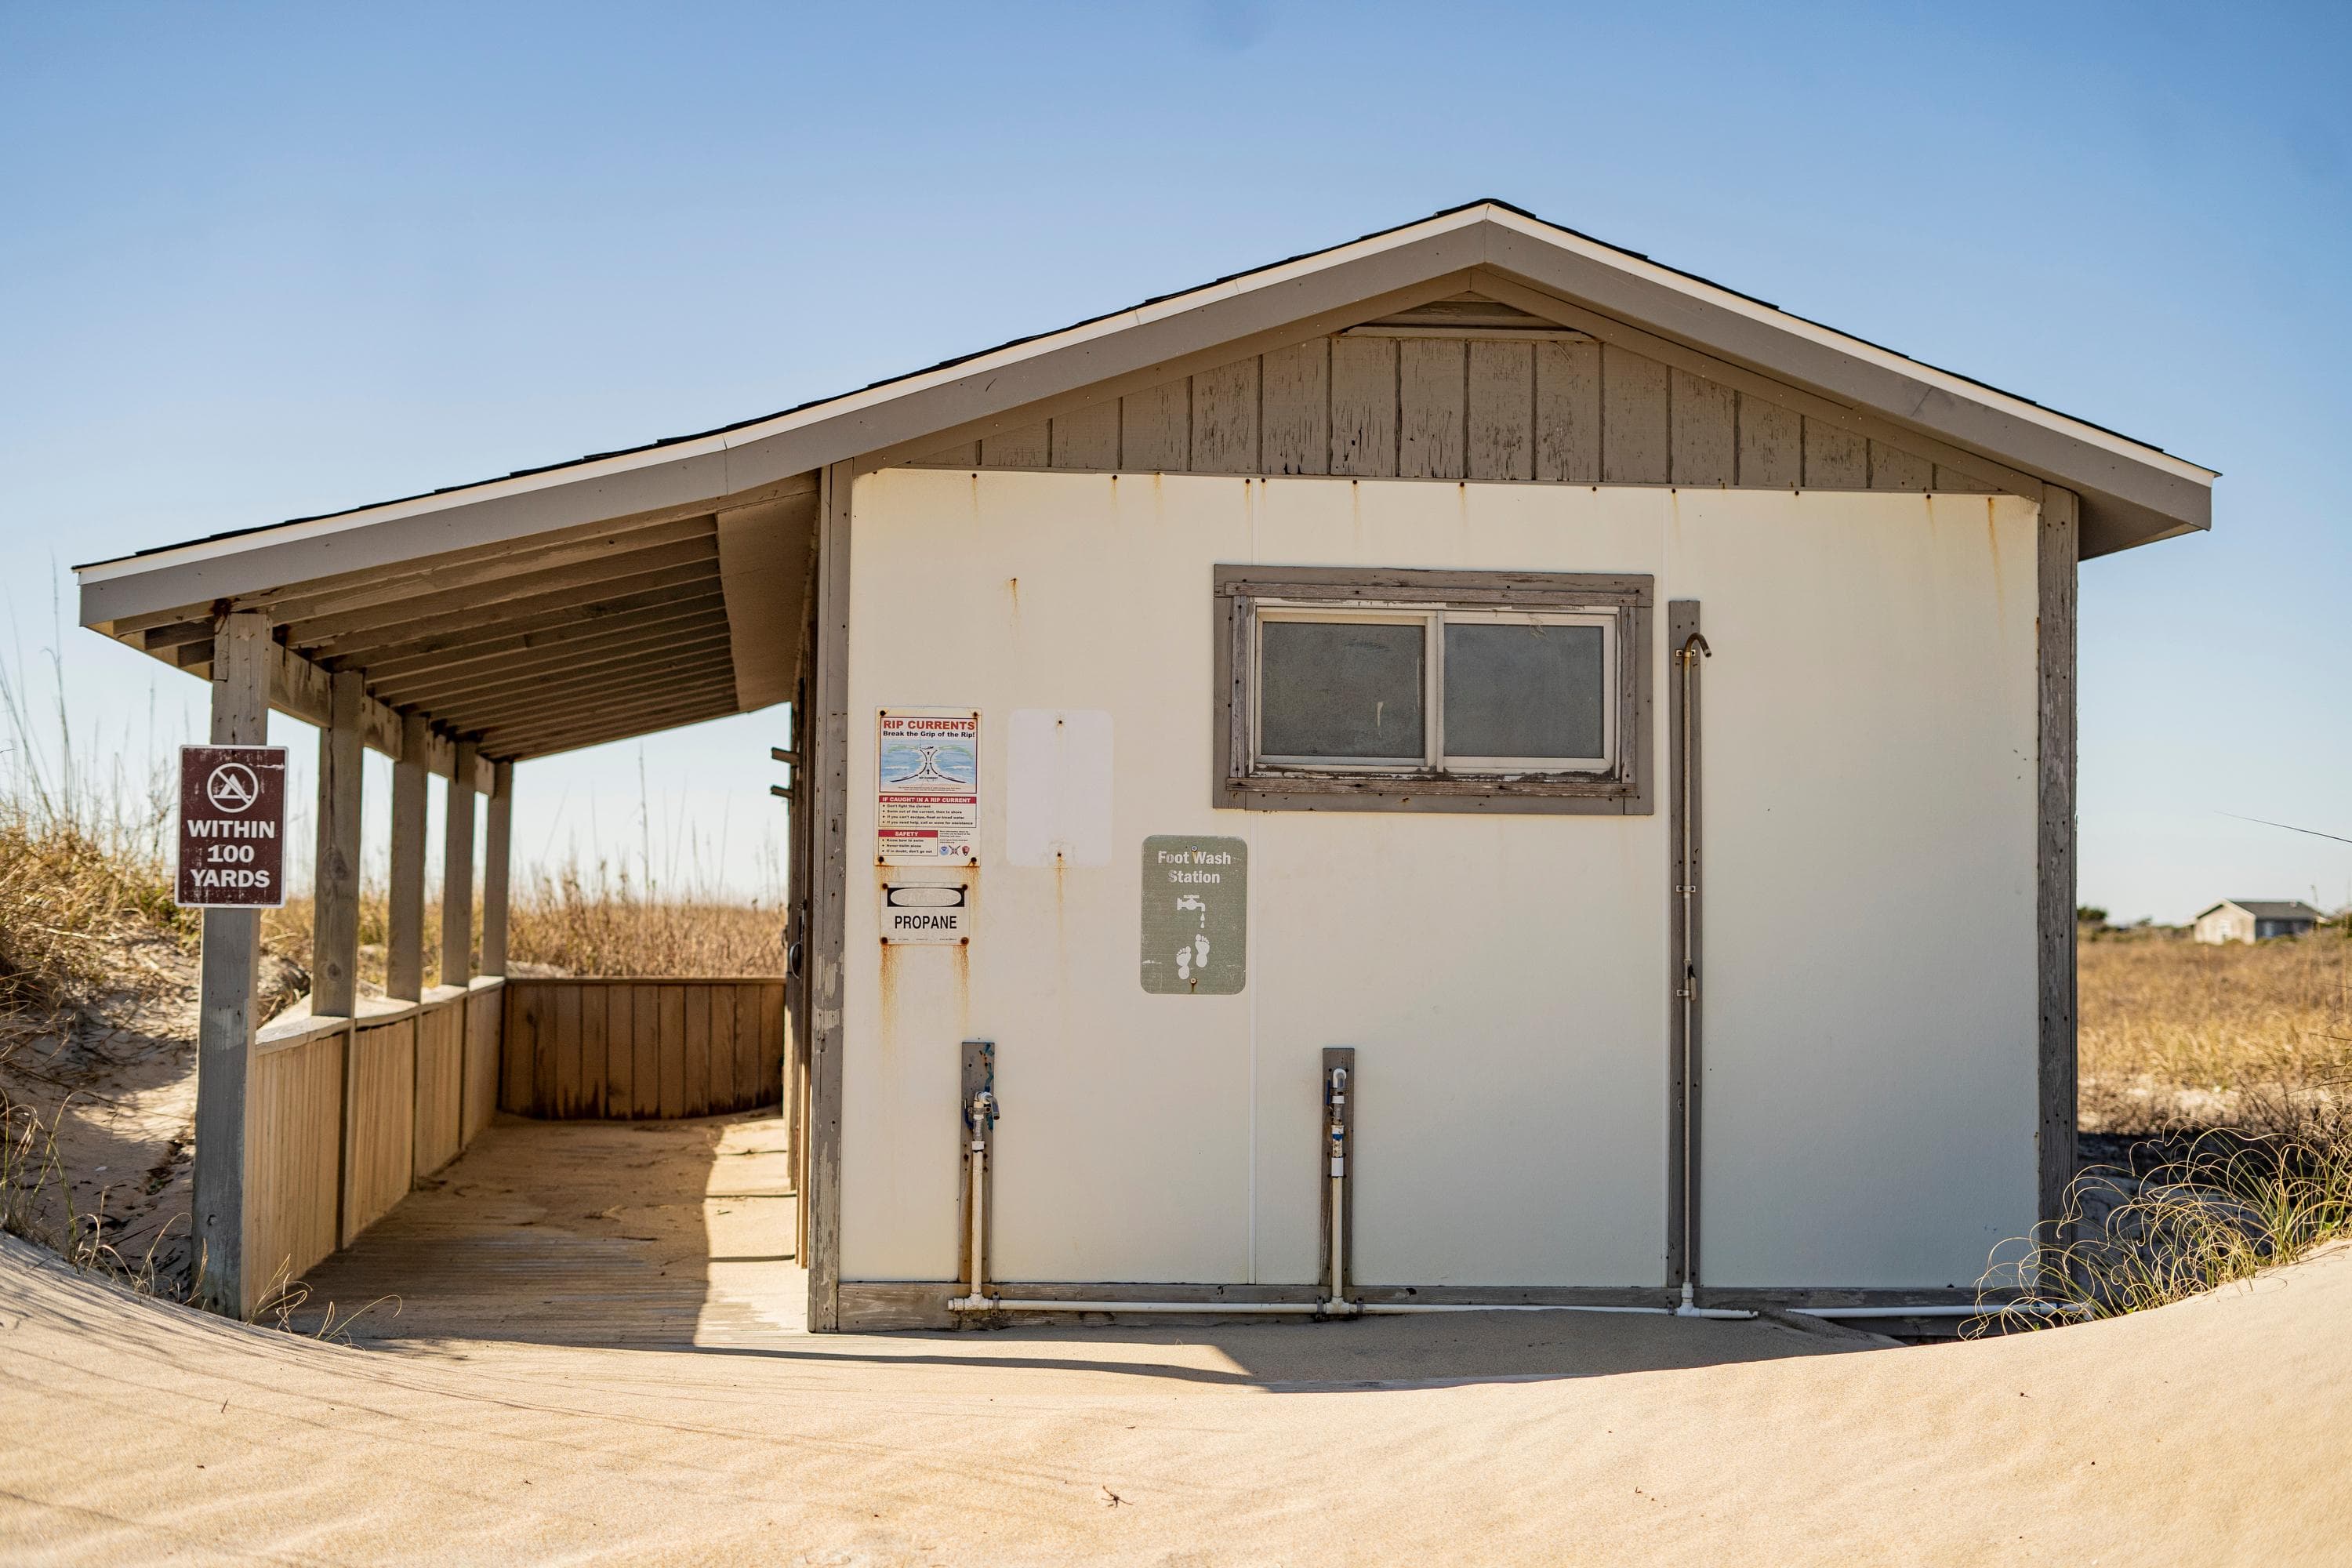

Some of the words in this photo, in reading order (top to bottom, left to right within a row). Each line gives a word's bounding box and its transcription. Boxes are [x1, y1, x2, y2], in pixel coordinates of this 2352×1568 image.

[884, 720, 903, 729] RIP
[908, 720, 975, 730] CURRENTS
[187, 820, 275, 838] WITHIN
[207, 844, 255, 863] 100
[1158, 851, 1189, 864] Foot
[1193, 851, 1231, 865] Wash
[190, 869, 270, 888] YARDS
[1168, 870, 1221, 884] Station
[895, 915, 957, 929] PROPANE
